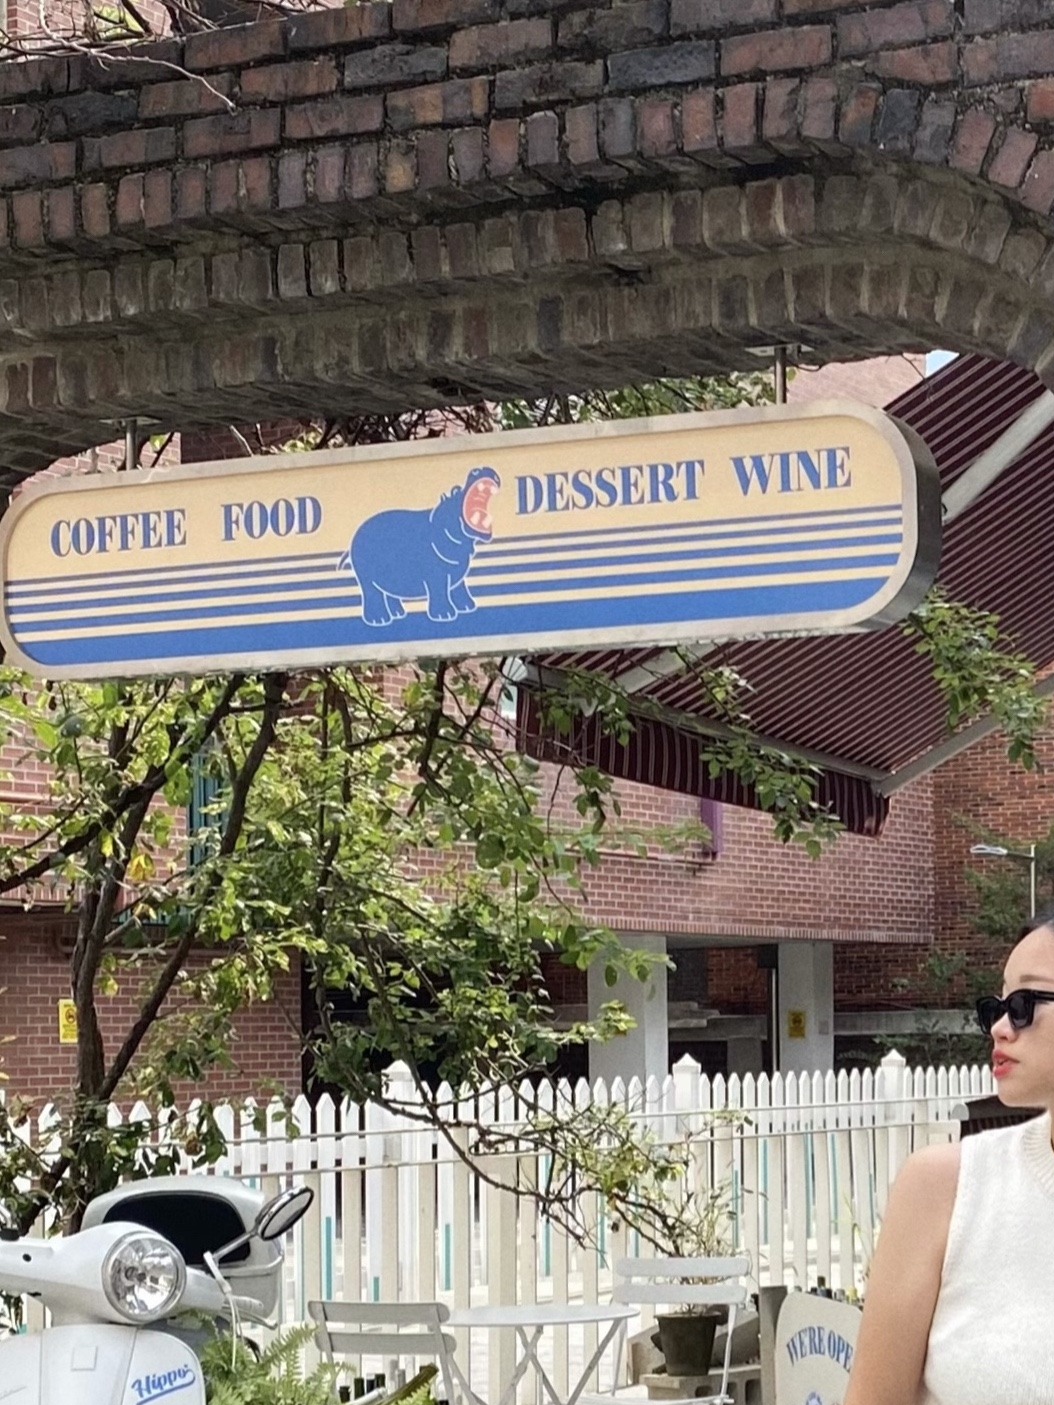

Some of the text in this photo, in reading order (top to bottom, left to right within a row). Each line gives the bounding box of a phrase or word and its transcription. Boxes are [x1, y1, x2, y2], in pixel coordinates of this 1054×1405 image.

[50, 447, 852, 558] COFFEE FOOD DESSERT WINE
[827, 1329, 854, 1374] OPE
[131, 1367, 194, 1399] Hippo
